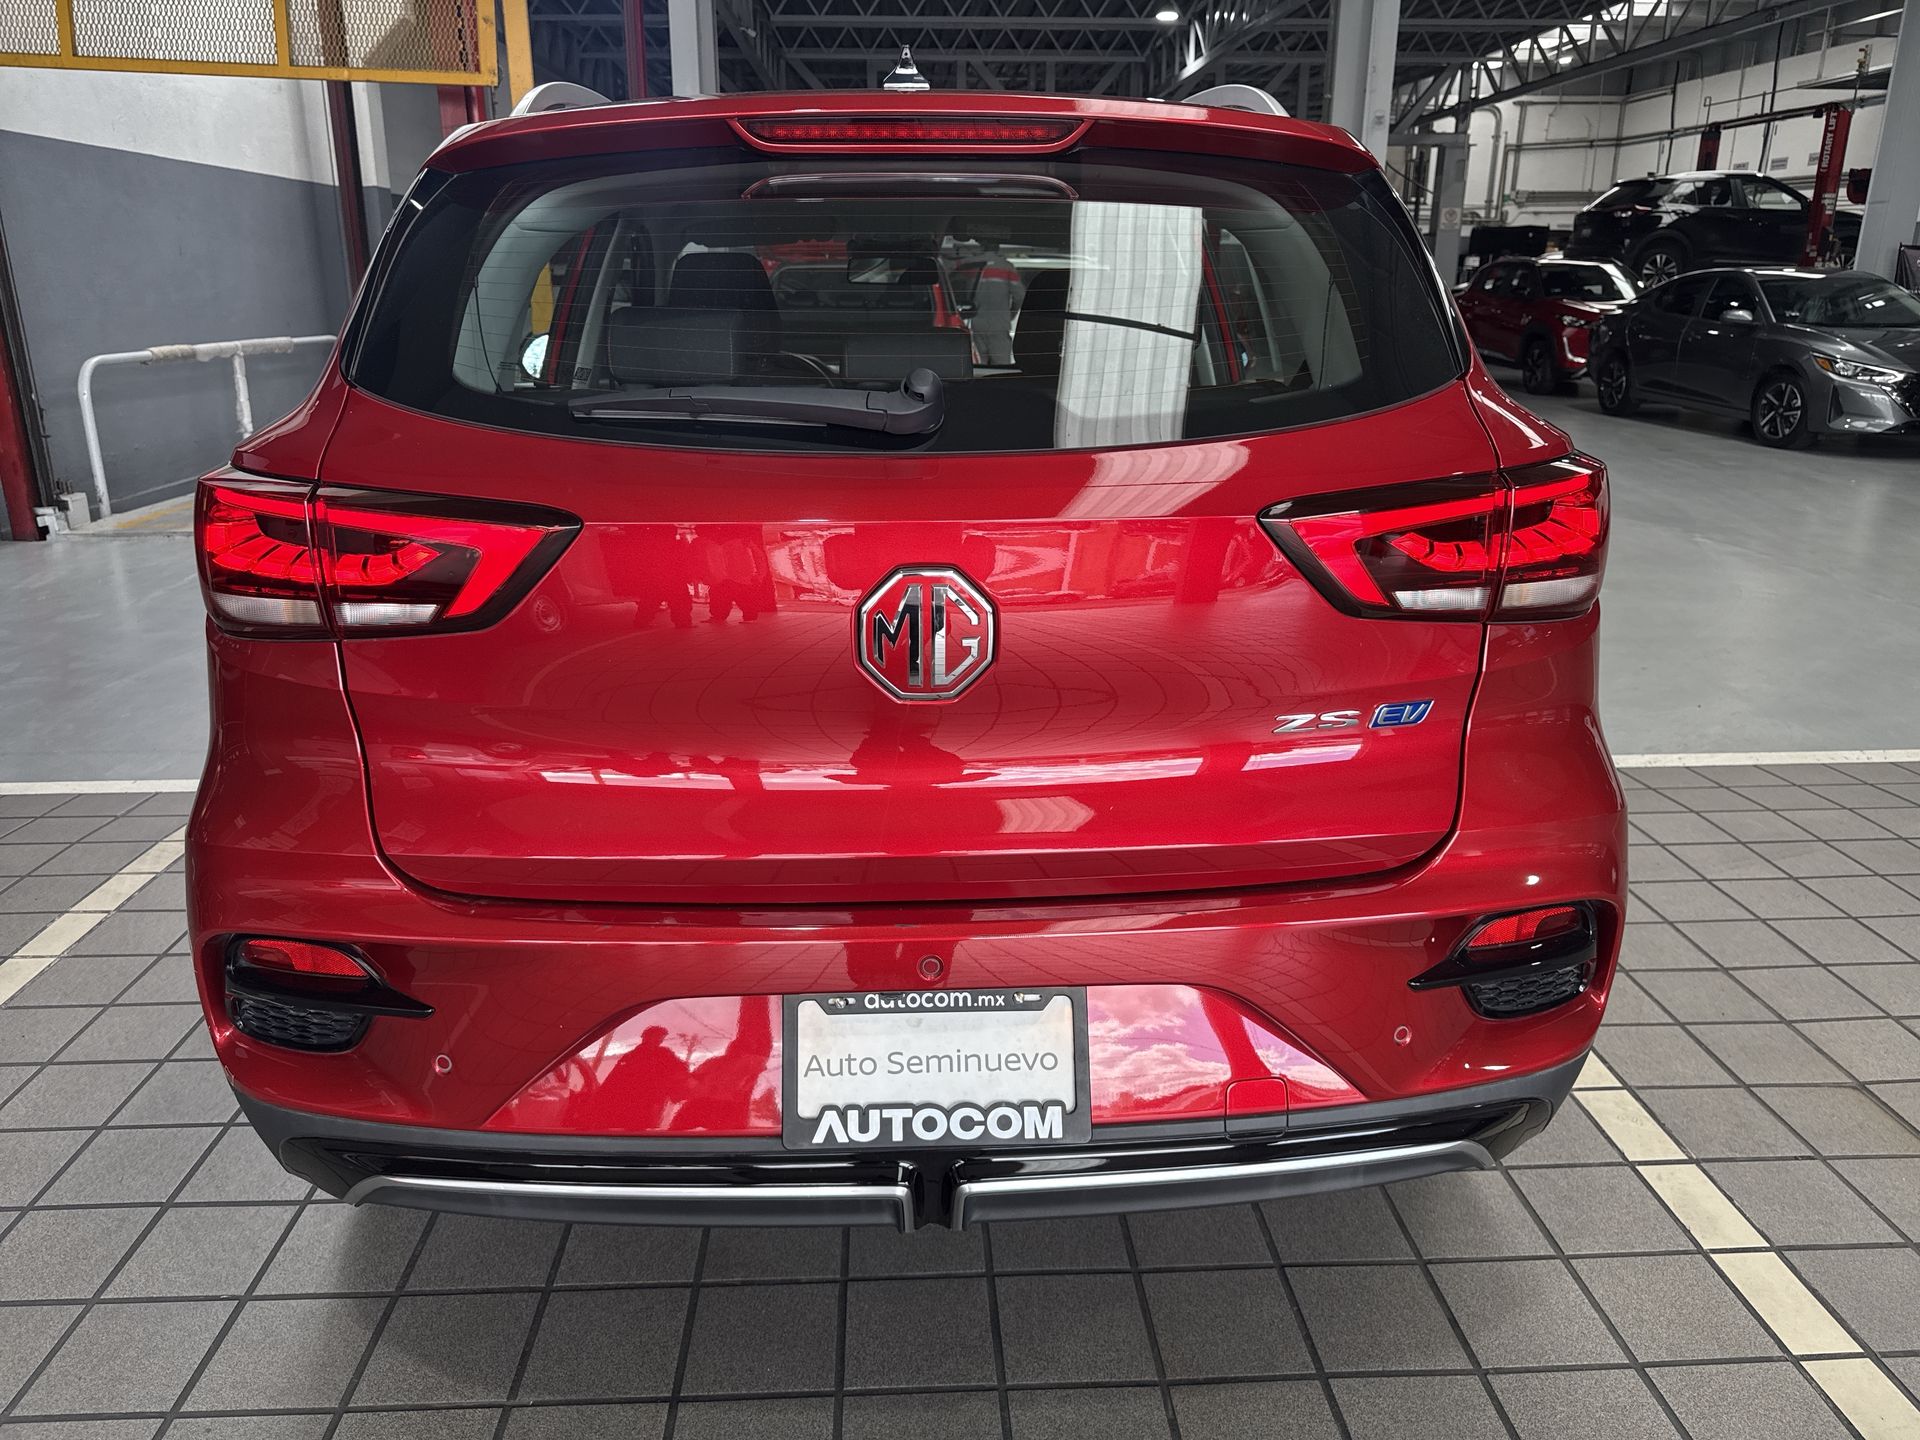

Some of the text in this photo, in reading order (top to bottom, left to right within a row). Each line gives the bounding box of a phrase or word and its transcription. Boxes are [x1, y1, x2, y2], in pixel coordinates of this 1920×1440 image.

[873, 583, 981, 688] MG
[1272, 702, 1430, 734] ZS EV
[864, 991, 1006, 1009] autocom.mx
[803, 1049, 1059, 1078] Auto Seminuevo
[811, 1106, 1064, 1144] AUTOCOM
